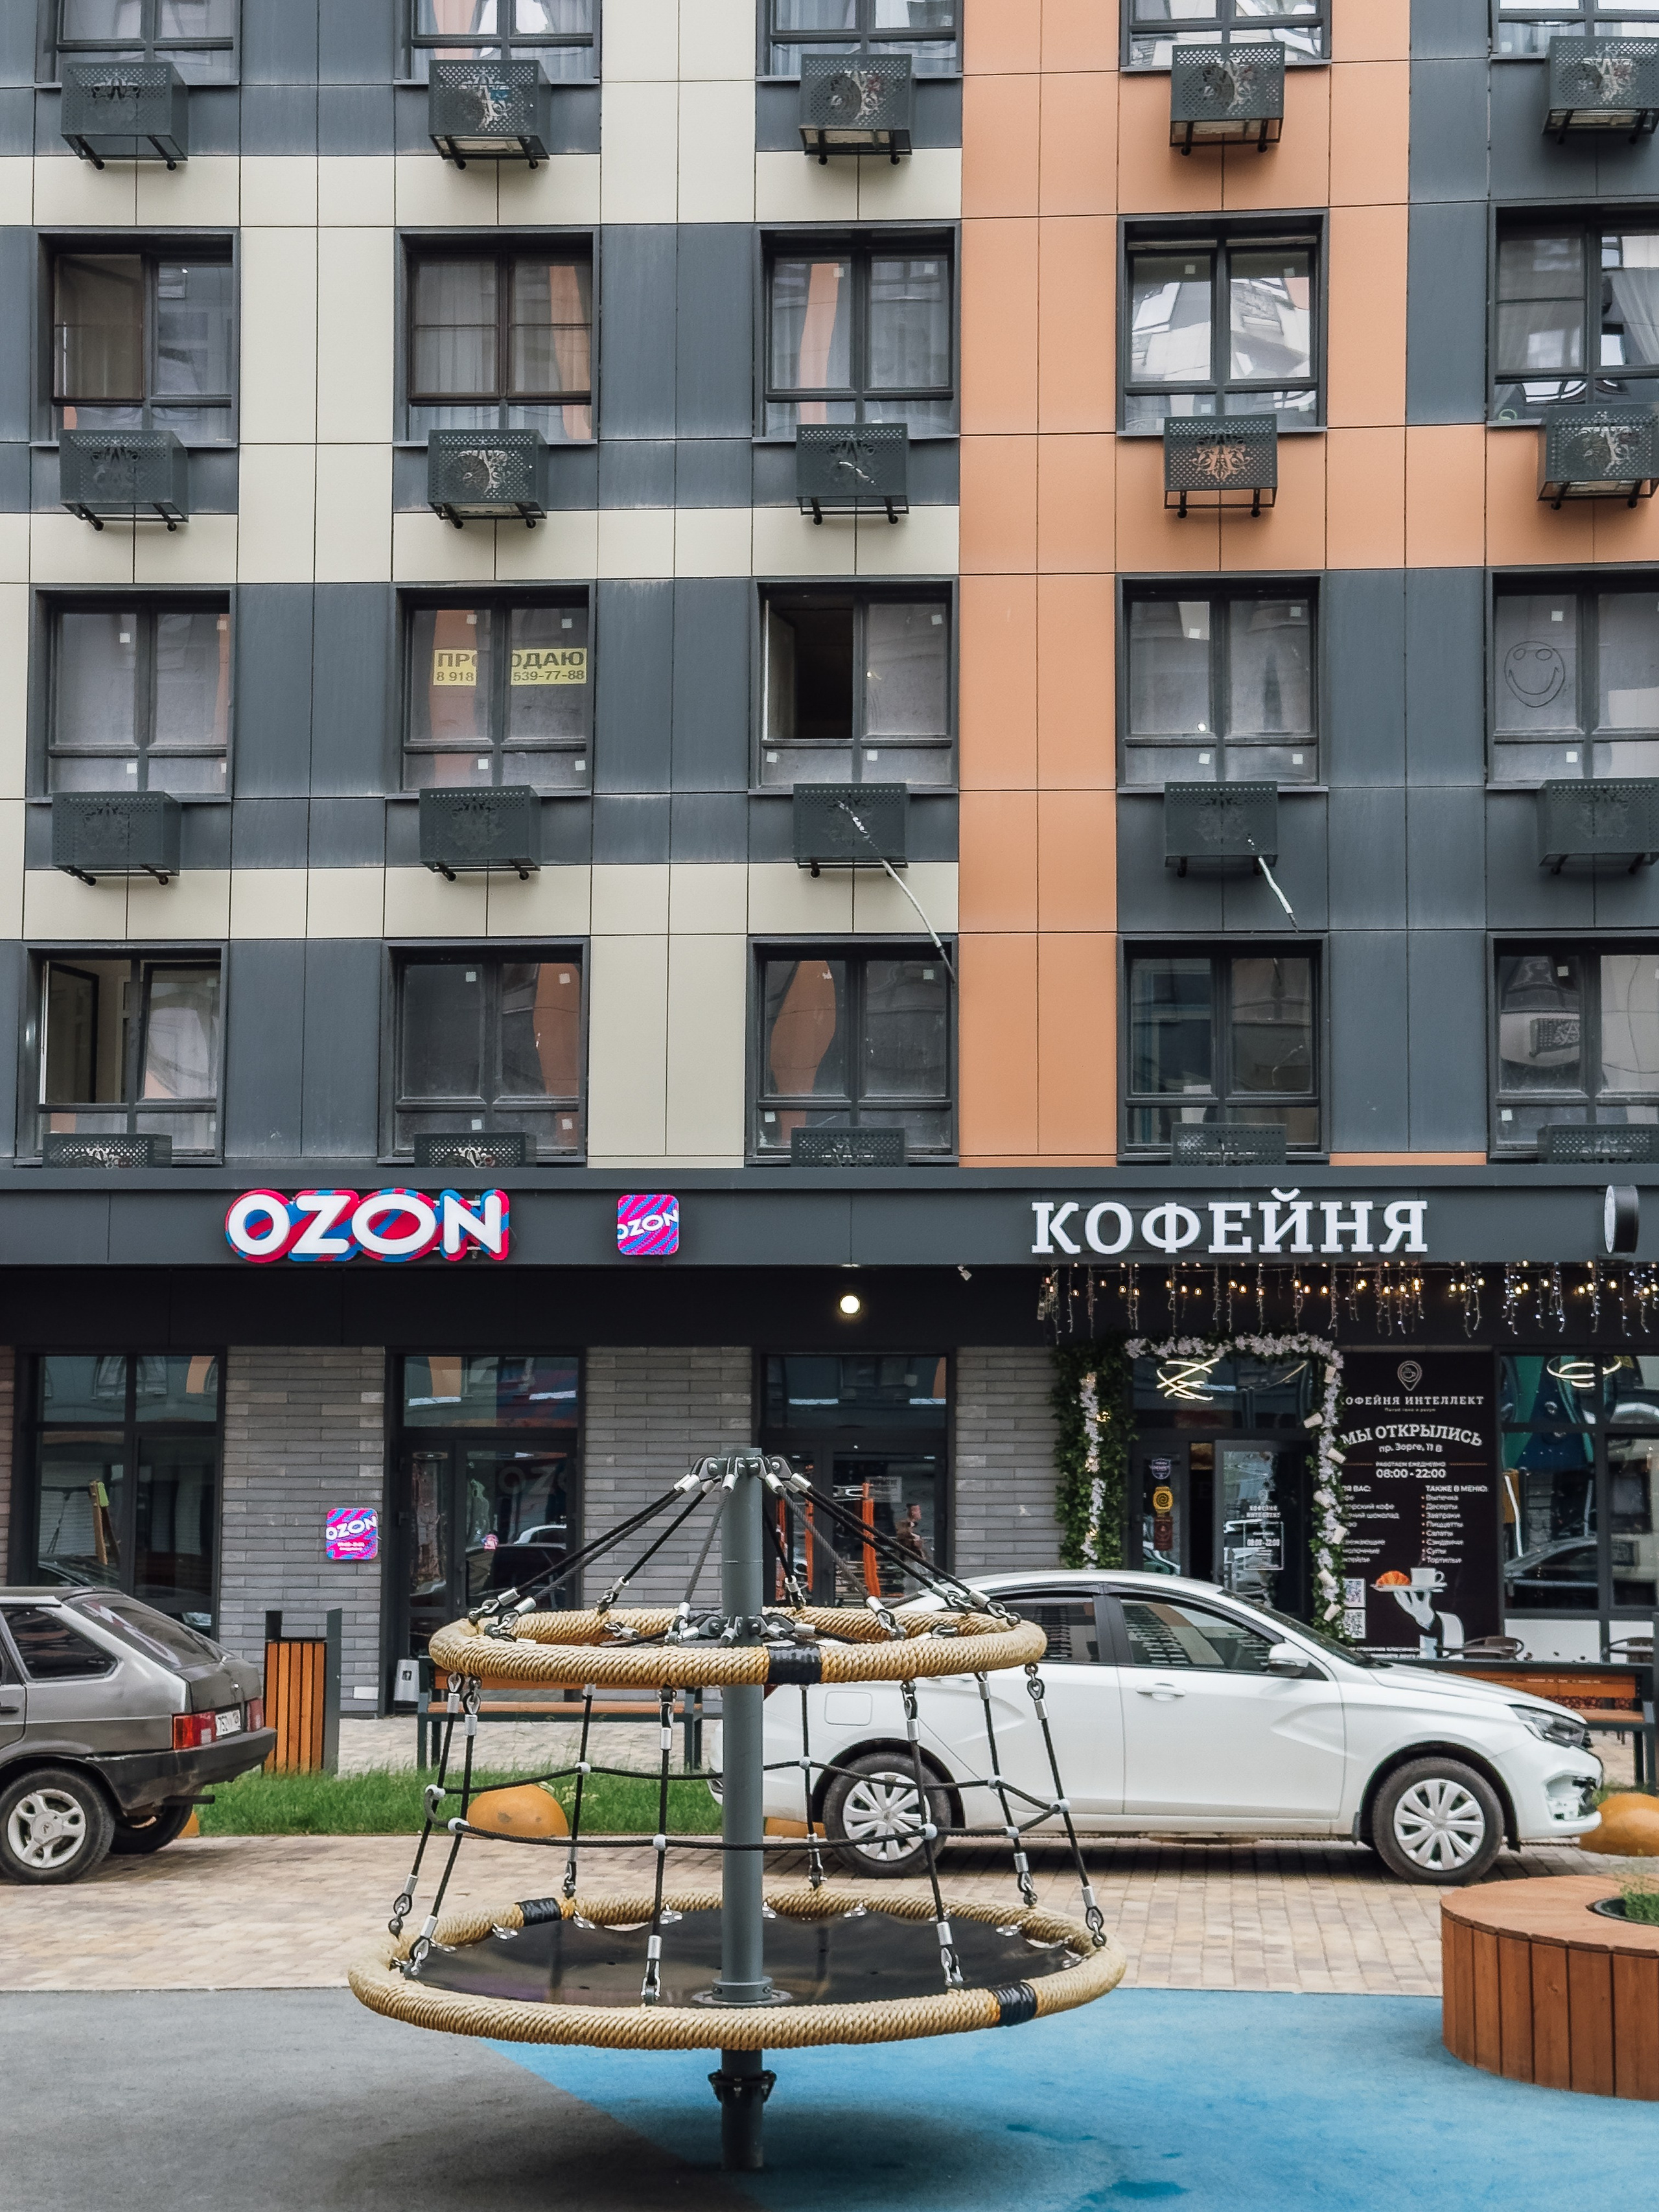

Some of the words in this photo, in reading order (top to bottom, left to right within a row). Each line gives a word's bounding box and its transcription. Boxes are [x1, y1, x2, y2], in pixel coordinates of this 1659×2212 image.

[436, 671, 445, 681] 8
[448, 671, 474, 681] 918
[513, 669, 584, 681] 539-77-88
[226, 1191, 505, 1257] OZON
[617, 1209, 679, 1240] OZON
[1031, 1187, 1428, 1255] КОФЕЙНЯ
[1341, 1395, 1400, 1405] ОФЕЙНЯ
[1404, 1395, 1484, 1405] ИНТЕЛЛЕКТ
[1340, 1428, 1373, 1445] МЫ
[1375, 1423, 1483, 1447] ОТКРЫЛИСЬ
[1376, 1469, 1408, 1478] 08:00
[1415, 1469, 1446, 1478] 22:00
[325, 1515, 378, 1541] OZON
